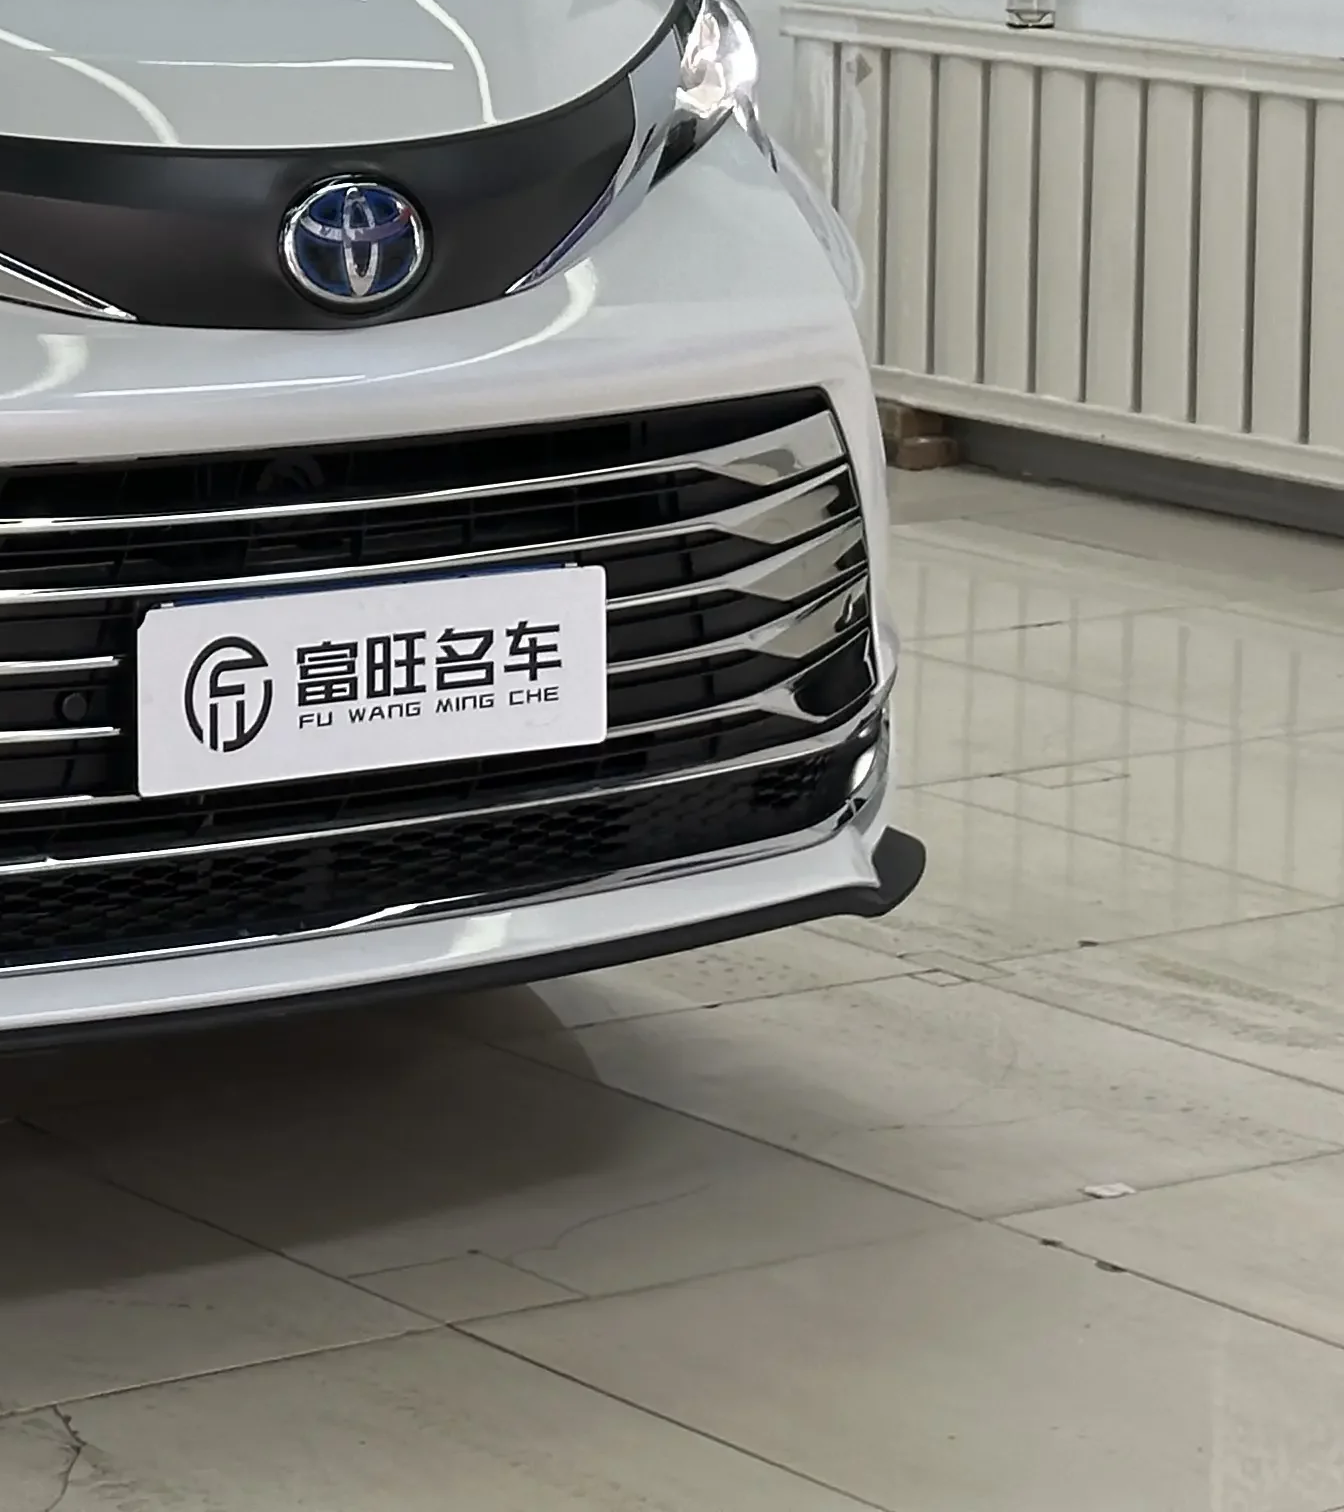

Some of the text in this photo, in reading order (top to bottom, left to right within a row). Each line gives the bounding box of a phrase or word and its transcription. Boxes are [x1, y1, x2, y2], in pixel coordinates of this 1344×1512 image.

[295, 620, 563, 707] 富旺名车
[298, 686, 560, 730] FU WANG MING CHE
